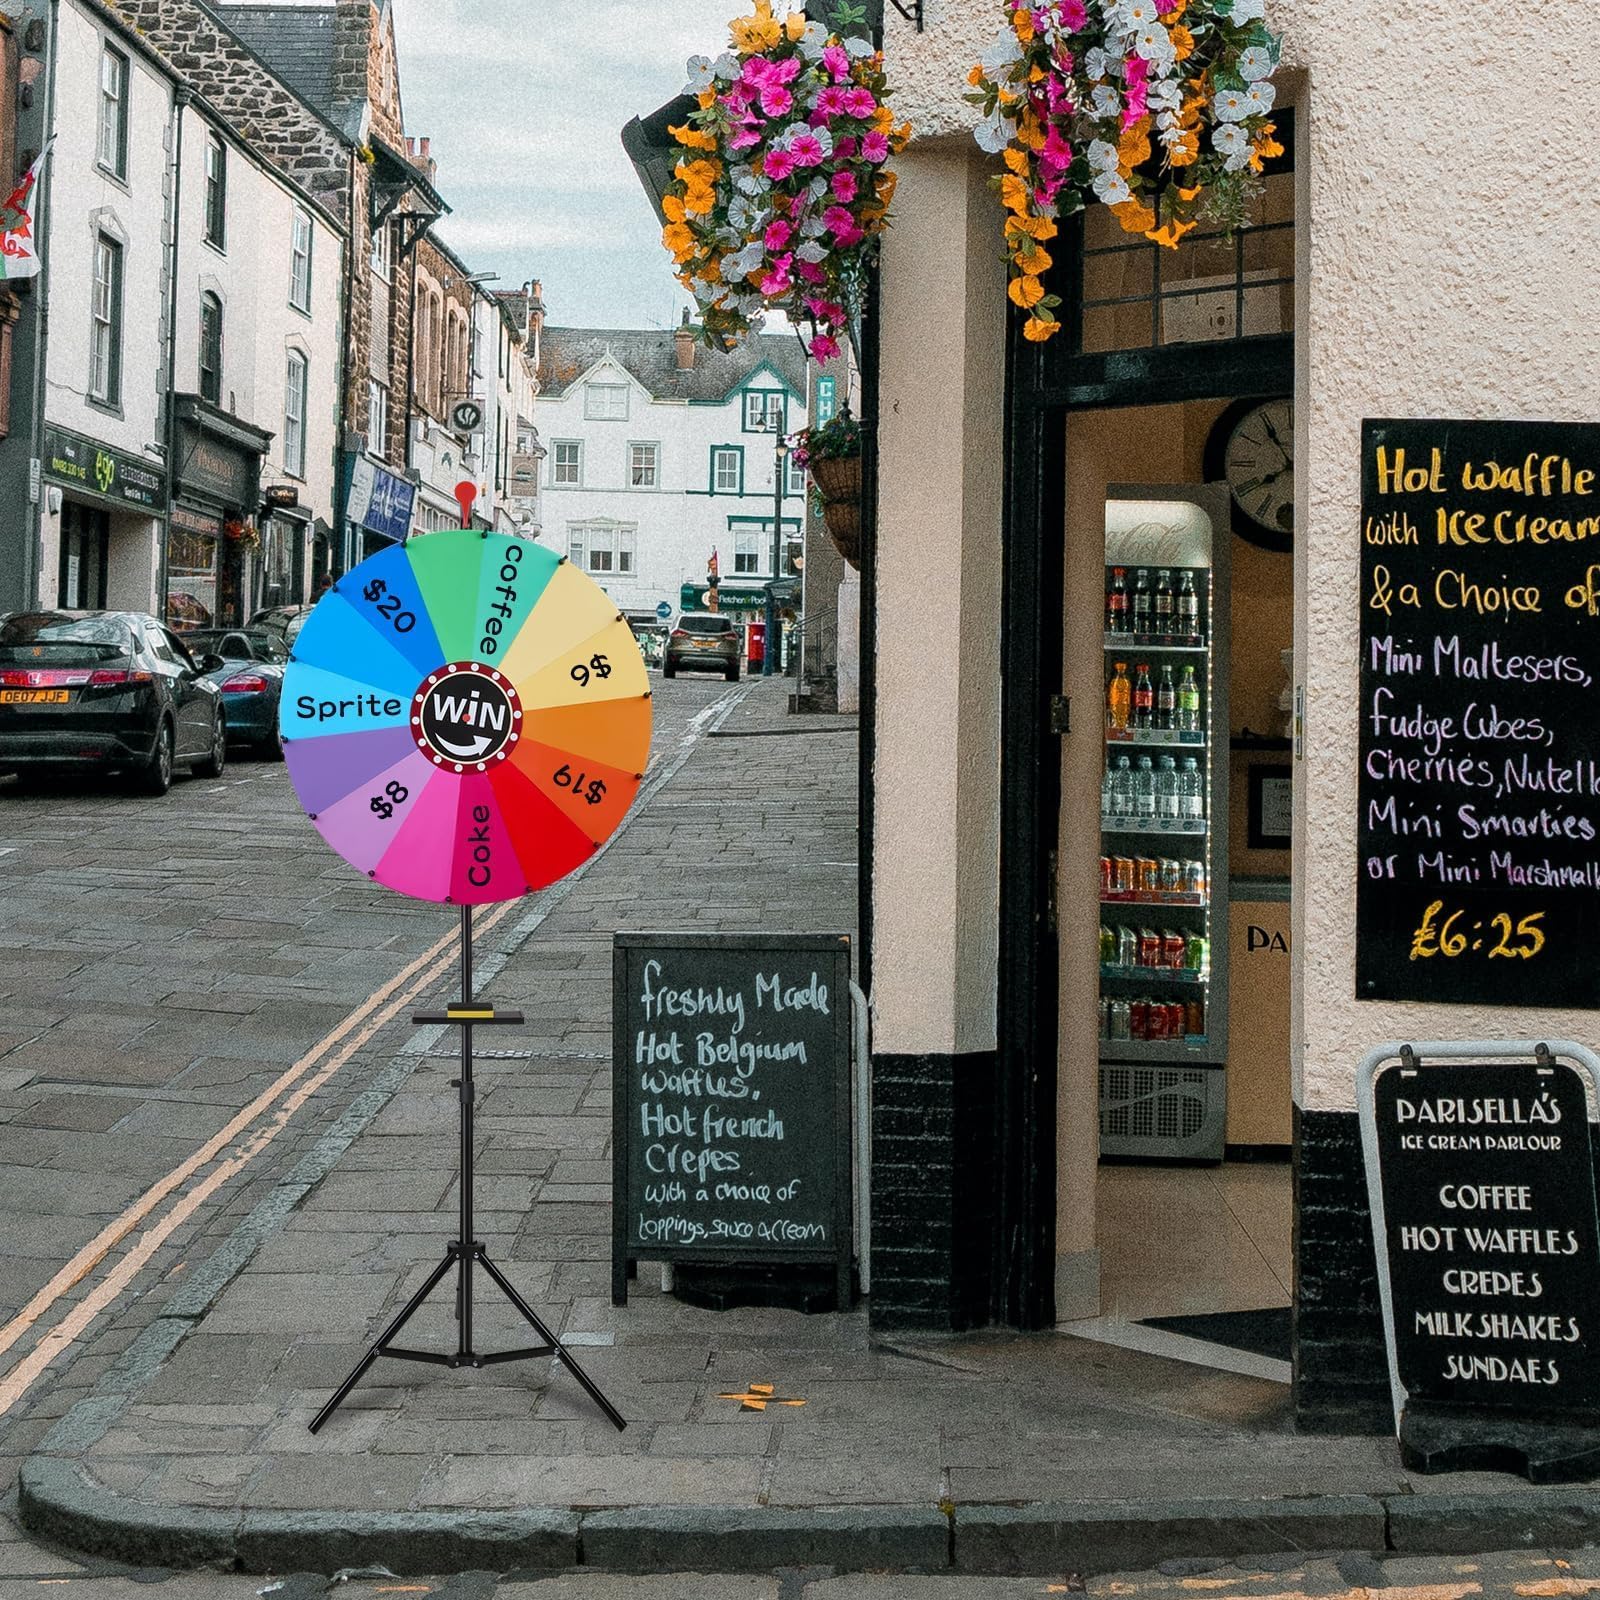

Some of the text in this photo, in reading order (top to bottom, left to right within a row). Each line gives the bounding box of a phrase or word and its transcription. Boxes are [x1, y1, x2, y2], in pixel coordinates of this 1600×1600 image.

[96, 451, 115, 492] ego
[1376, 445, 1596, 496] Hot waffle
[1366, 511, 1419, 545] with
[363, 579, 417, 633] $20
[1369, 564, 1600, 616] & a Choice of
[1371, 634, 1592, 687] Mini Maltesers,
[5, 691, 65, 702] OE07 JJF
[297, 694, 401, 722] Sprite
[1369, 687, 1553, 756] fudge Cubes,
[370, 780, 409, 820] $8
[1368, 796, 1596, 841] Mini Smarties
[468, 804, 492, 887] Coke
[1367, 854, 1398, 879] or
[1418, 850, 1480, 883] Mini
[1248, 925, 1292, 952] PA
[756, 972, 830, 1015] Made
[636, 1031, 807, 1078] Hot Belgium
[641, 1103, 783, 1144] Hot french
[1397, 1092, 1562, 1124] PARISELLA'S
[1401, 1135, 1562, 1151] ICE CREAM PARLOUR
[645, 1144, 741, 1182] Crepes
[645, 1182, 686, 1202] with
[696, 1189, 709, 1201] a
[776, 1179, 801, 1200] of
[1439, 1184, 1532, 1211] COFFEE
[1401, 1226, 1578, 1255] HOT WAFFLES
[1443, 1269, 1543, 1297] CREPES
[1443, 1355, 1559, 1384] SUNDAES
